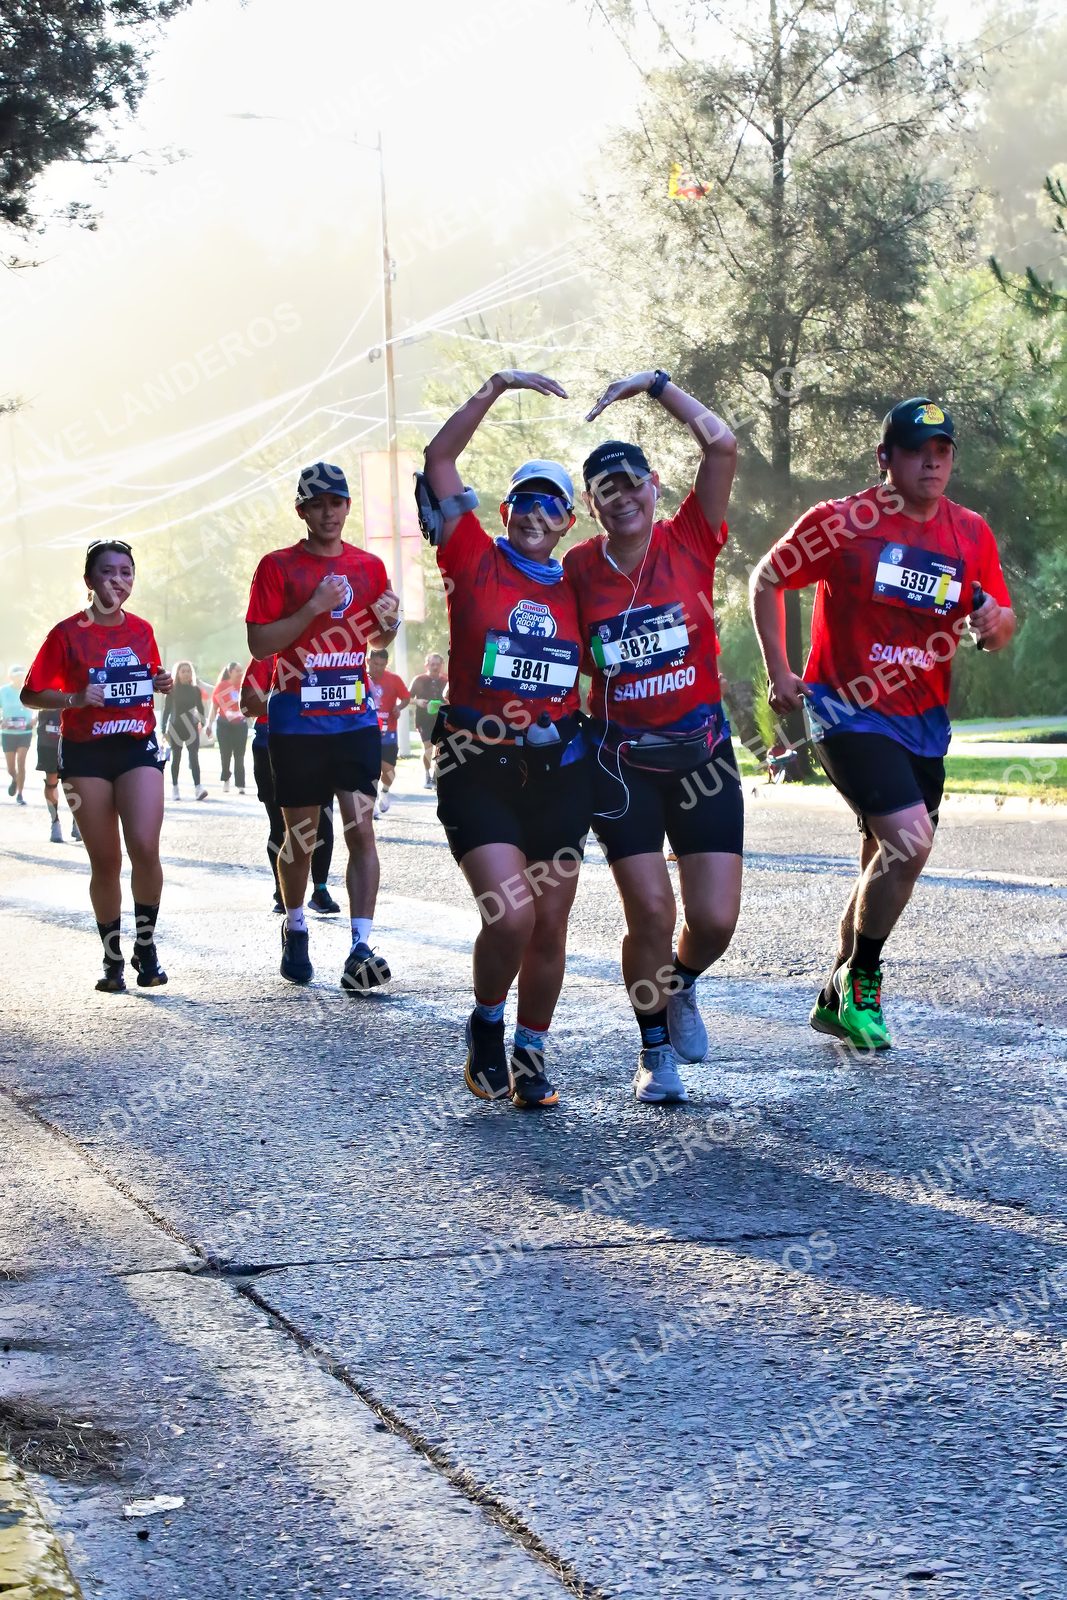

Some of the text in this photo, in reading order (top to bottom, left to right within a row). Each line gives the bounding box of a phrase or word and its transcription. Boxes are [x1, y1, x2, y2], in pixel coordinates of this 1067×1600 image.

[900, 569, 938, 595] 5397
[521, 612, 545, 623] Global
[934, 607, 948, 617] 10K
[516, 618, 536, 628] Race
[619, 633, 662, 661] 3822
[304, 652, 365, 669] SANTIAGO
[670, 659, 685, 668] 10K
[511, 659, 550, 683] 3841
[110, 682, 138, 697] 5467
[614, 666, 696, 702] SANTIAGO
[321, 686, 348, 701] 5641
